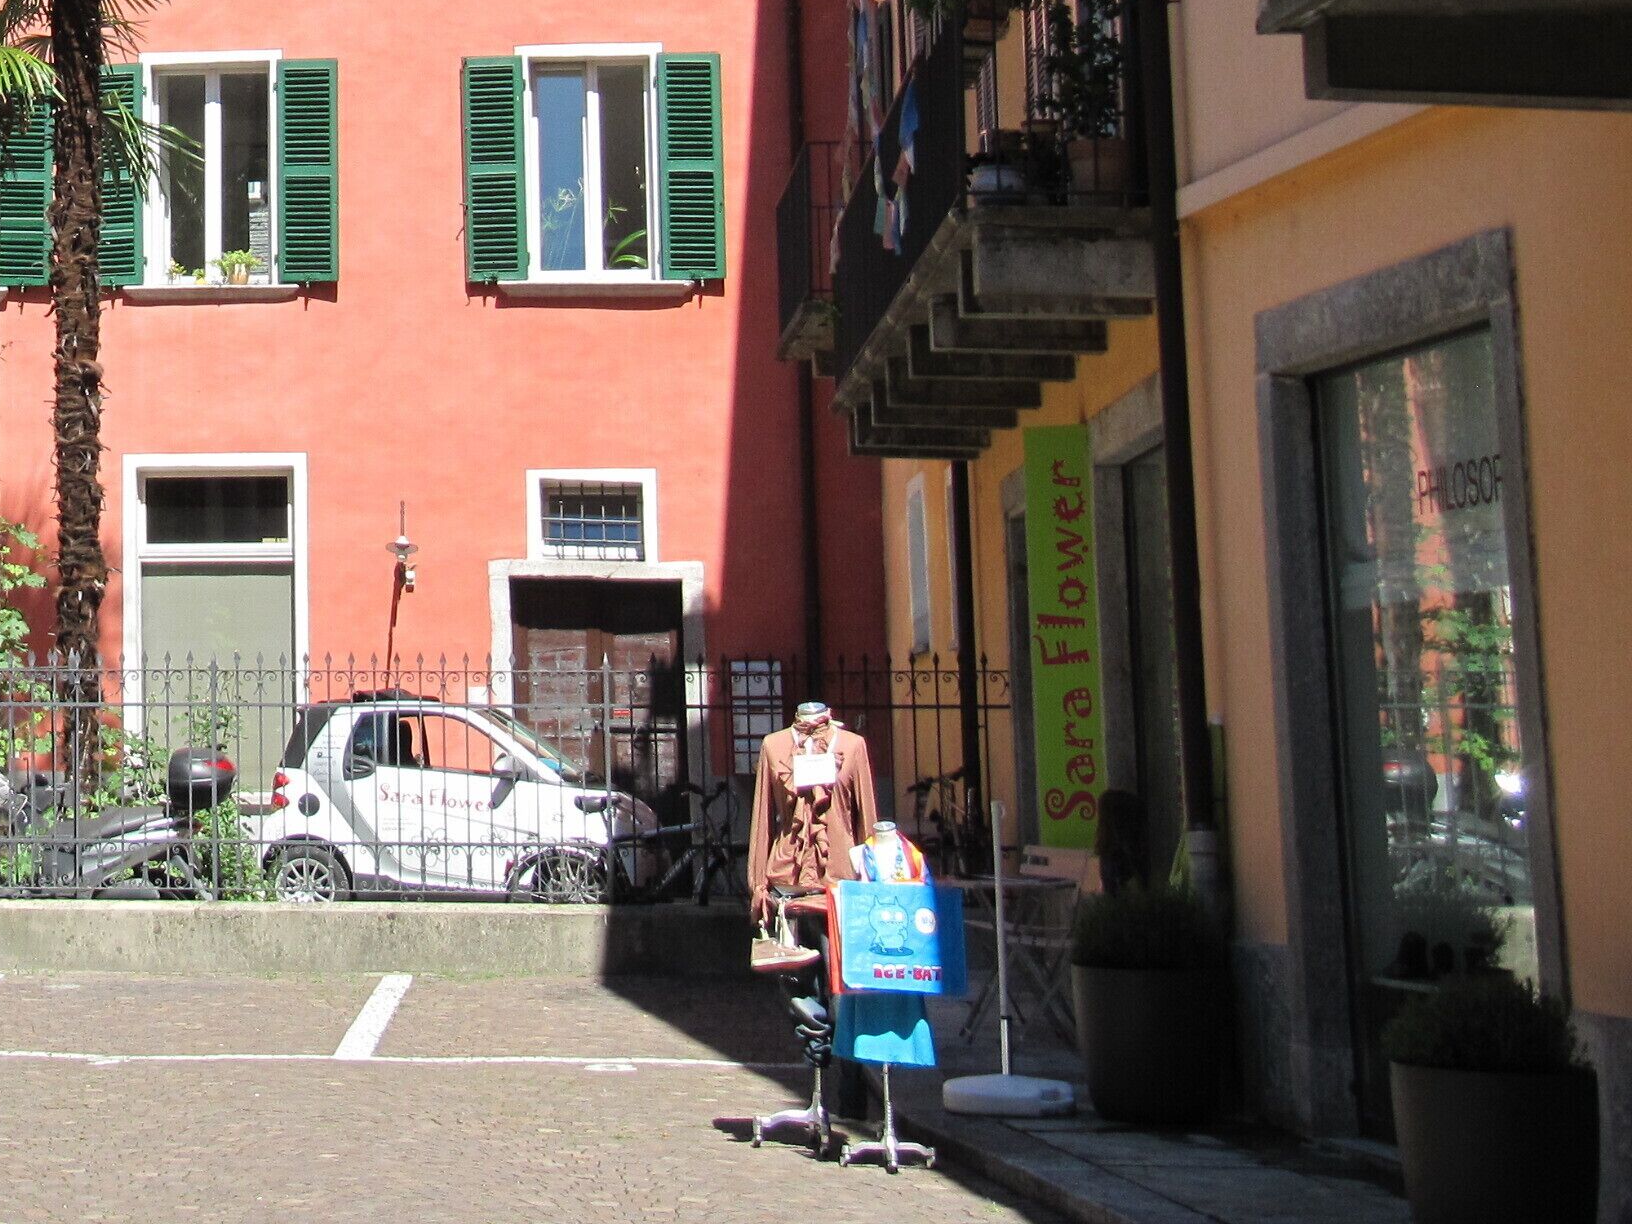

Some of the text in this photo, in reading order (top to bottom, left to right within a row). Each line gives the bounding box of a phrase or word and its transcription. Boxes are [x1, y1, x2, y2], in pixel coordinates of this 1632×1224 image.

[1033, 458, 1097, 821] Sara Flower
[378, 782, 424, 806] Sara
